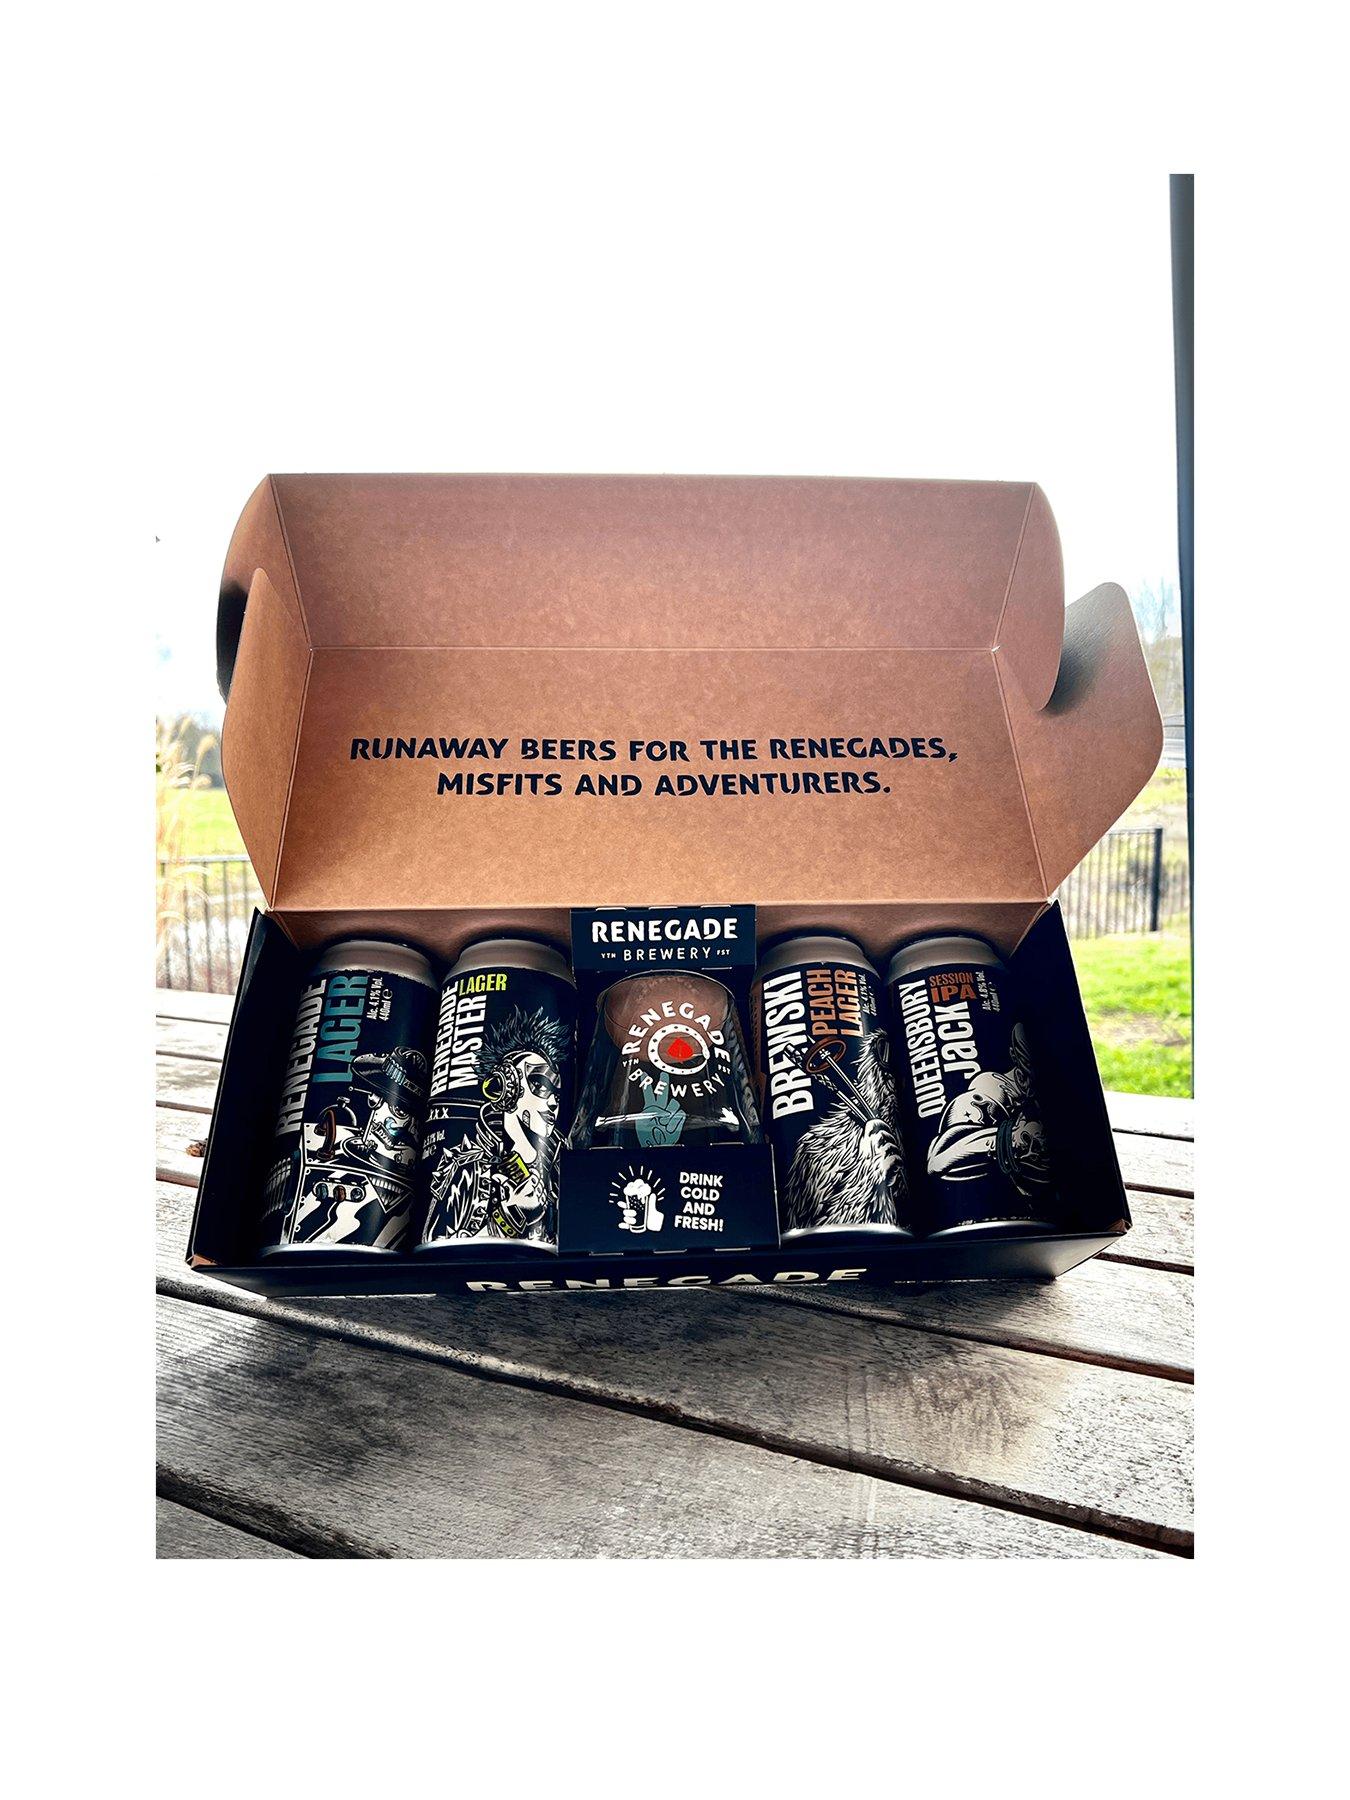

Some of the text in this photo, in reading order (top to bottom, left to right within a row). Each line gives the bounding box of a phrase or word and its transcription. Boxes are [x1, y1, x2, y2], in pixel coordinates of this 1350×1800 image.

[350, 737, 959, 763] RUNAWAY BEERS FOR THE RENEGADES,
[436, 771, 892, 797] MISFITS AND ADVENTURERS.
[592, 918, 738, 943] RENEGADE
[623, 947, 711, 961] BREWERY
[458, 973, 508, 996] LAGER
[929, 972, 974, 987] SESSION
[369, 989, 381, 1007] 4.1%
[806, 968, 838, 1035] PEACH
[834, 969, 865, 1038] LAGER
[932, 985, 978, 1004] IPA
[312, 975, 370, 1083] LAGER
[429, 980, 458, 1097] RENEGADE
[622, 1001, 731, 1063] RENEGADE
[448, 995, 487, 1091] MASTER
[763, 971, 815, 1120] BREWSKI
[898, 979, 948, 1119] QUEENSBURY
[275, 979, 327, 1137] RENEGADE
[628, 1068, 725, 1098] BREWERY
[679, 1171, 724, 1188] DRINK
[680, 1186, 720, 1201] COLD
[682, 1201, 716, 1216] AND
[674, 1214, 724, 1232] FRESH!
[466, 1268, 867, 1293] RENEGADE
